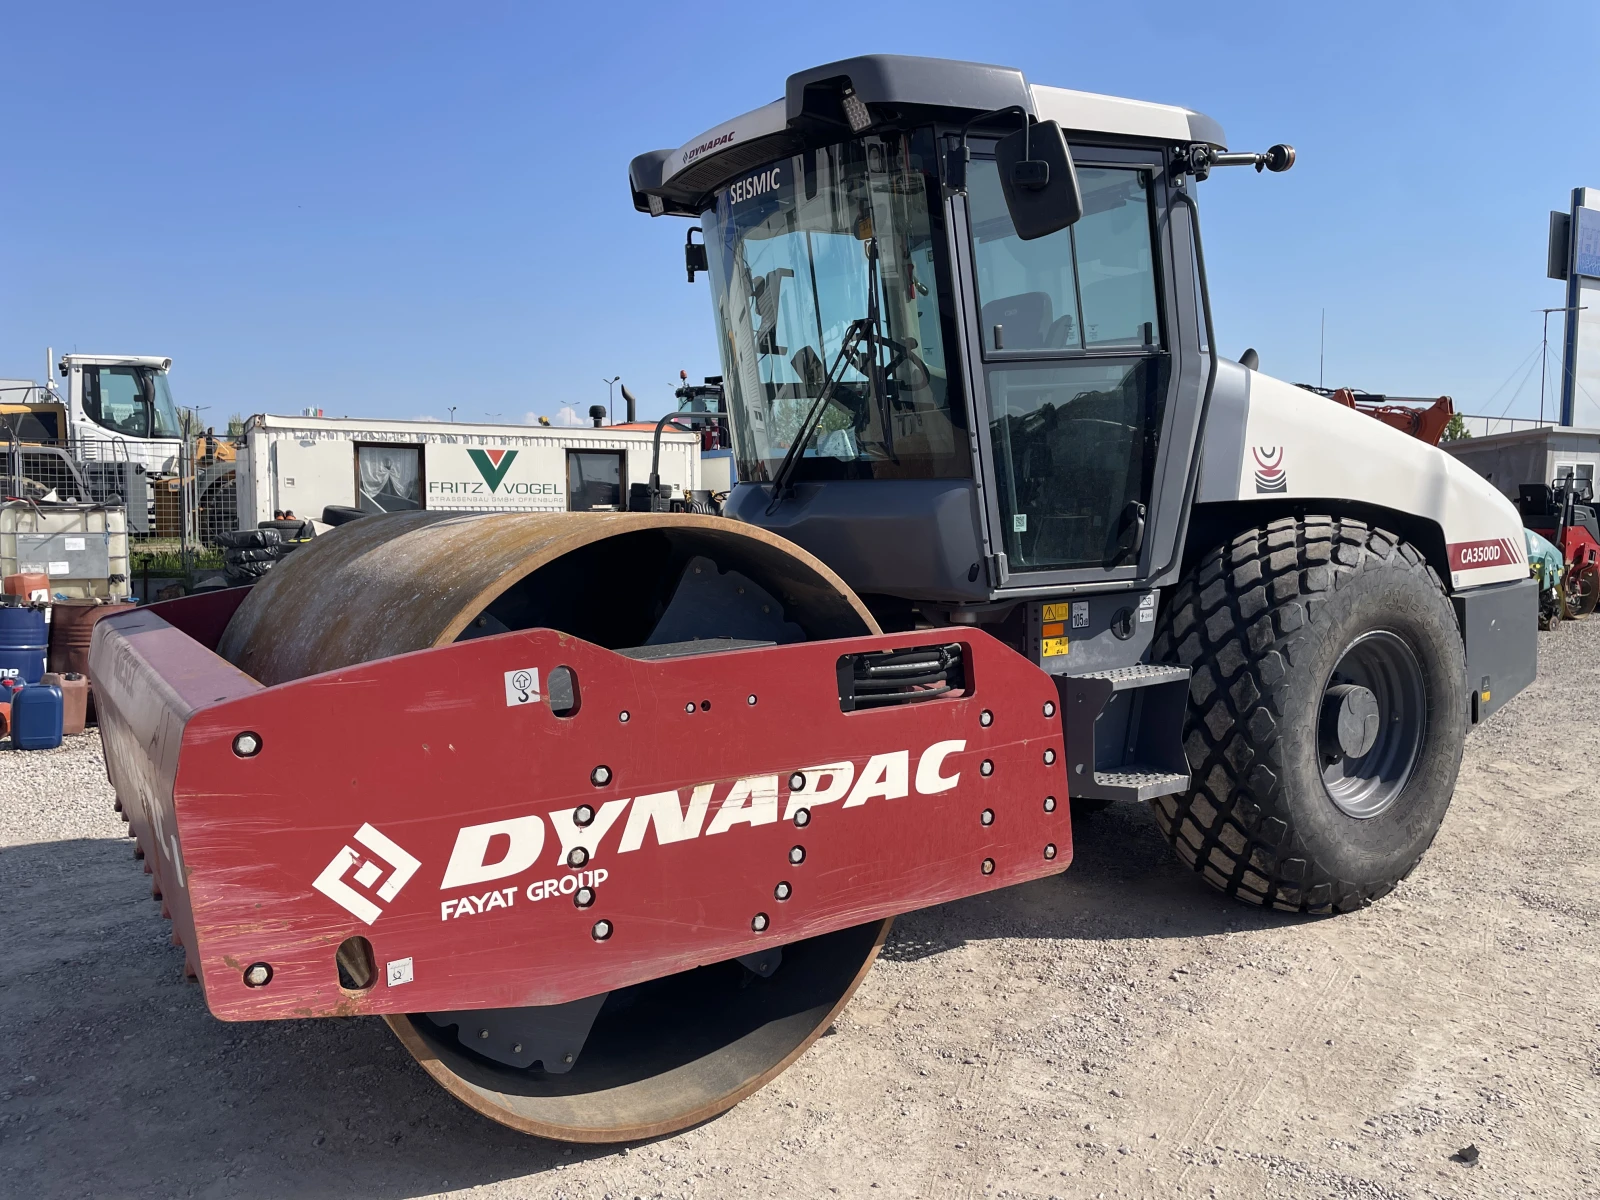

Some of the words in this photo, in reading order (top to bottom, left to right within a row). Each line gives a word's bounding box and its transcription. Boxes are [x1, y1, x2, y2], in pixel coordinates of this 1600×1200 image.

[688, 131, 736, 160] DYNAPAC
[730, 167, 781, 205] SEISMIC
[429, 481, 484, 494] FRITZ
[502, 482, 563, 495] VOGEL
[1461, 545, 1501, 564] CA3500D
[1073, 613, 1084, 627] 105
[439, 739, 967, 890] DYNAPAC
[441, 886, 518, 922] FAYAT
[526, 867, 609, 903] GROUP
